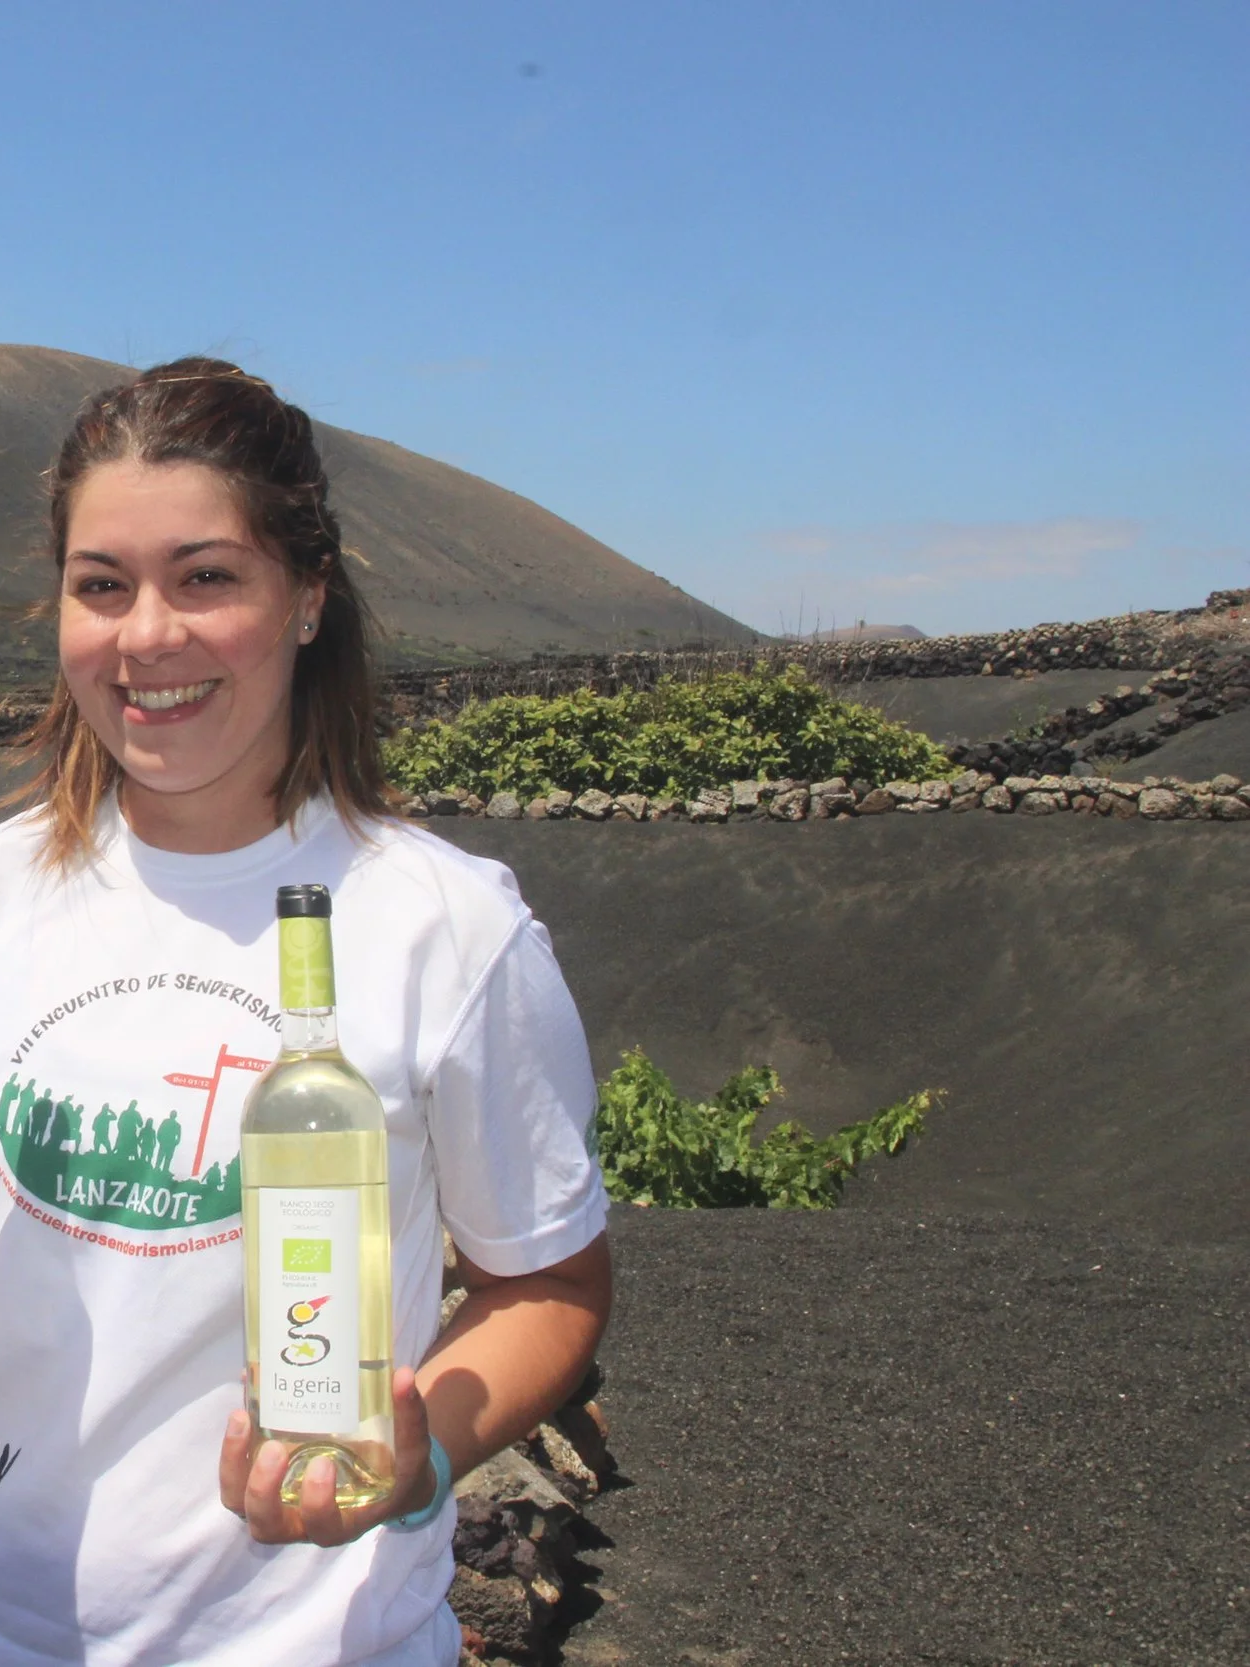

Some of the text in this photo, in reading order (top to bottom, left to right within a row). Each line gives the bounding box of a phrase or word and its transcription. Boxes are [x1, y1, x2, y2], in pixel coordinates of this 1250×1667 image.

[10, 1037, 34, 1064] VII
[31, 978, 140, 1039] ENCUENTRO
[147, 973, 169, 990] DE
[56, 1174, 202, 1222] LANZAROTE
[274, 1372, 341, 1398] la geria
[273, 1400, 342, 1411] LANZAROTE
